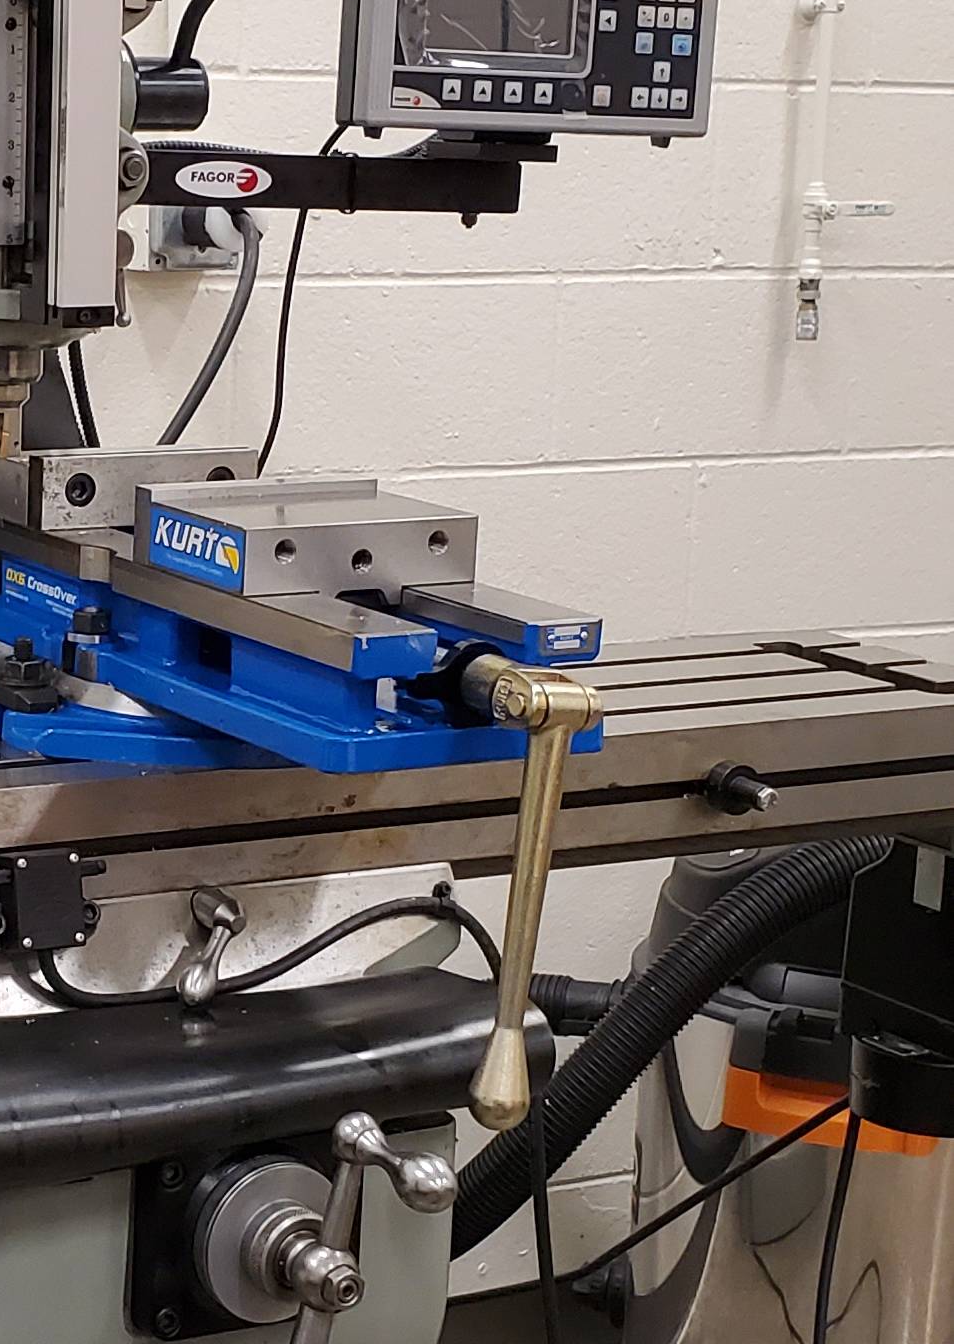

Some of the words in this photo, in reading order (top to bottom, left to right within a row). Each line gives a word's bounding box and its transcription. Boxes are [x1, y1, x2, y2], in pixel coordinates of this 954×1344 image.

[664, 12, 670, 22] 0
[10, 44, 15, 55] 1
[8, 92, 15, 103] 2
[8, 140, 14, 150] 3
[190, 172, 235, 184] FAGOR
[6, 234, 14, 244] 5
[154, 517, 220, 561] KURT
[27, 576, 77, 605] CrossOver
